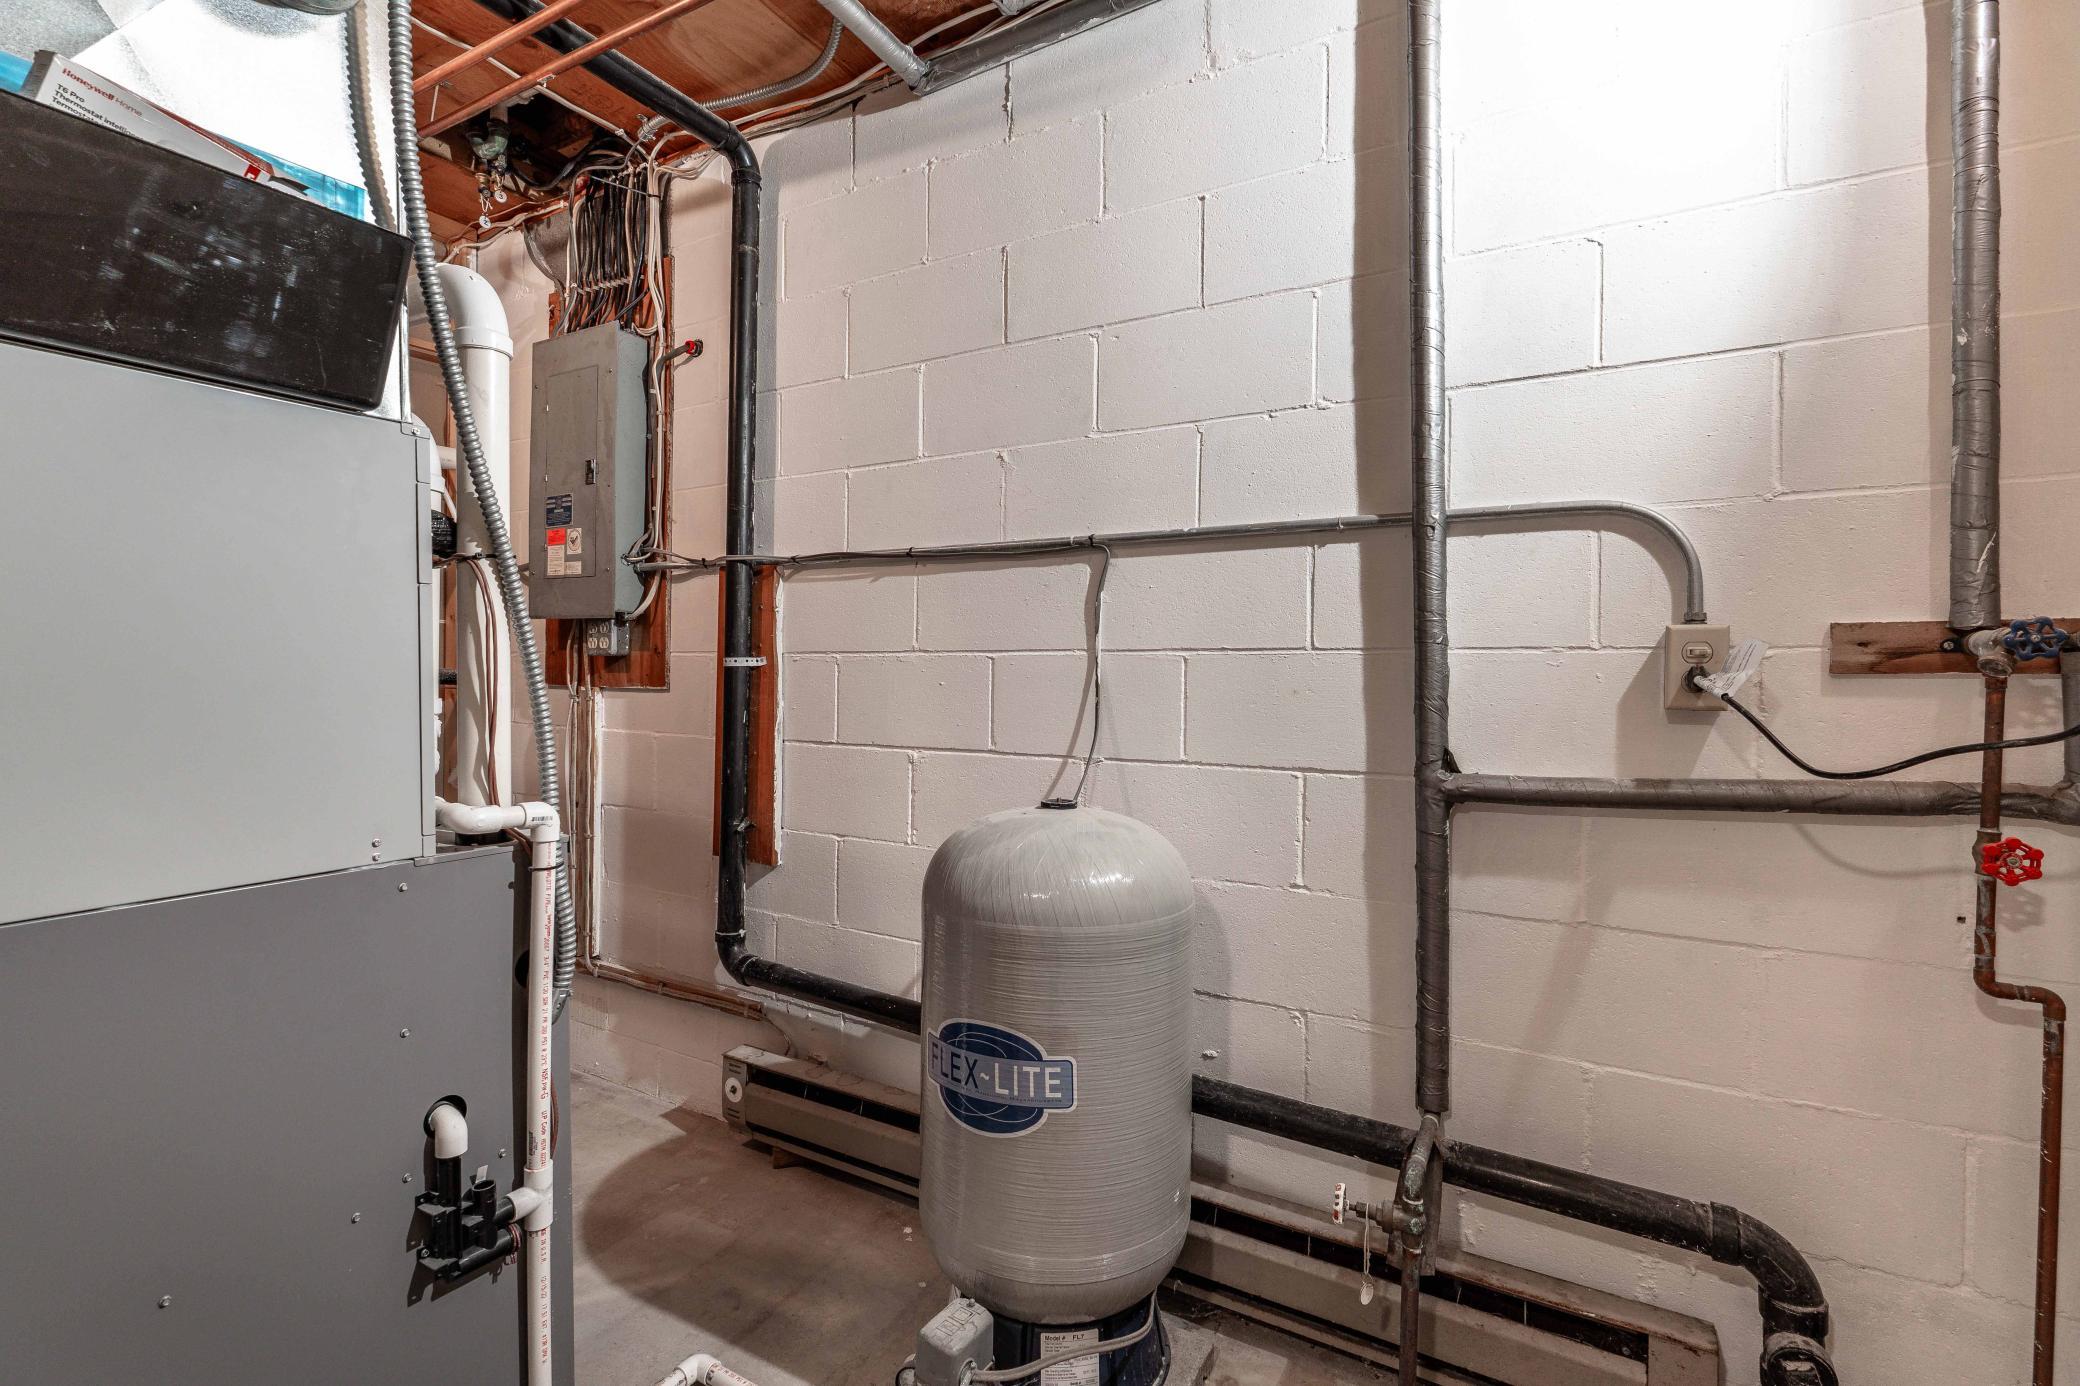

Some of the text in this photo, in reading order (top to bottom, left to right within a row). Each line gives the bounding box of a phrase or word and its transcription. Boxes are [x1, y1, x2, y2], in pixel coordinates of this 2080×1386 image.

[55, 90, 104, 121] Thermostat
[57, 83, 85, 103] T6 Pro
[62, 68, 142, 116] Honeywell Home
